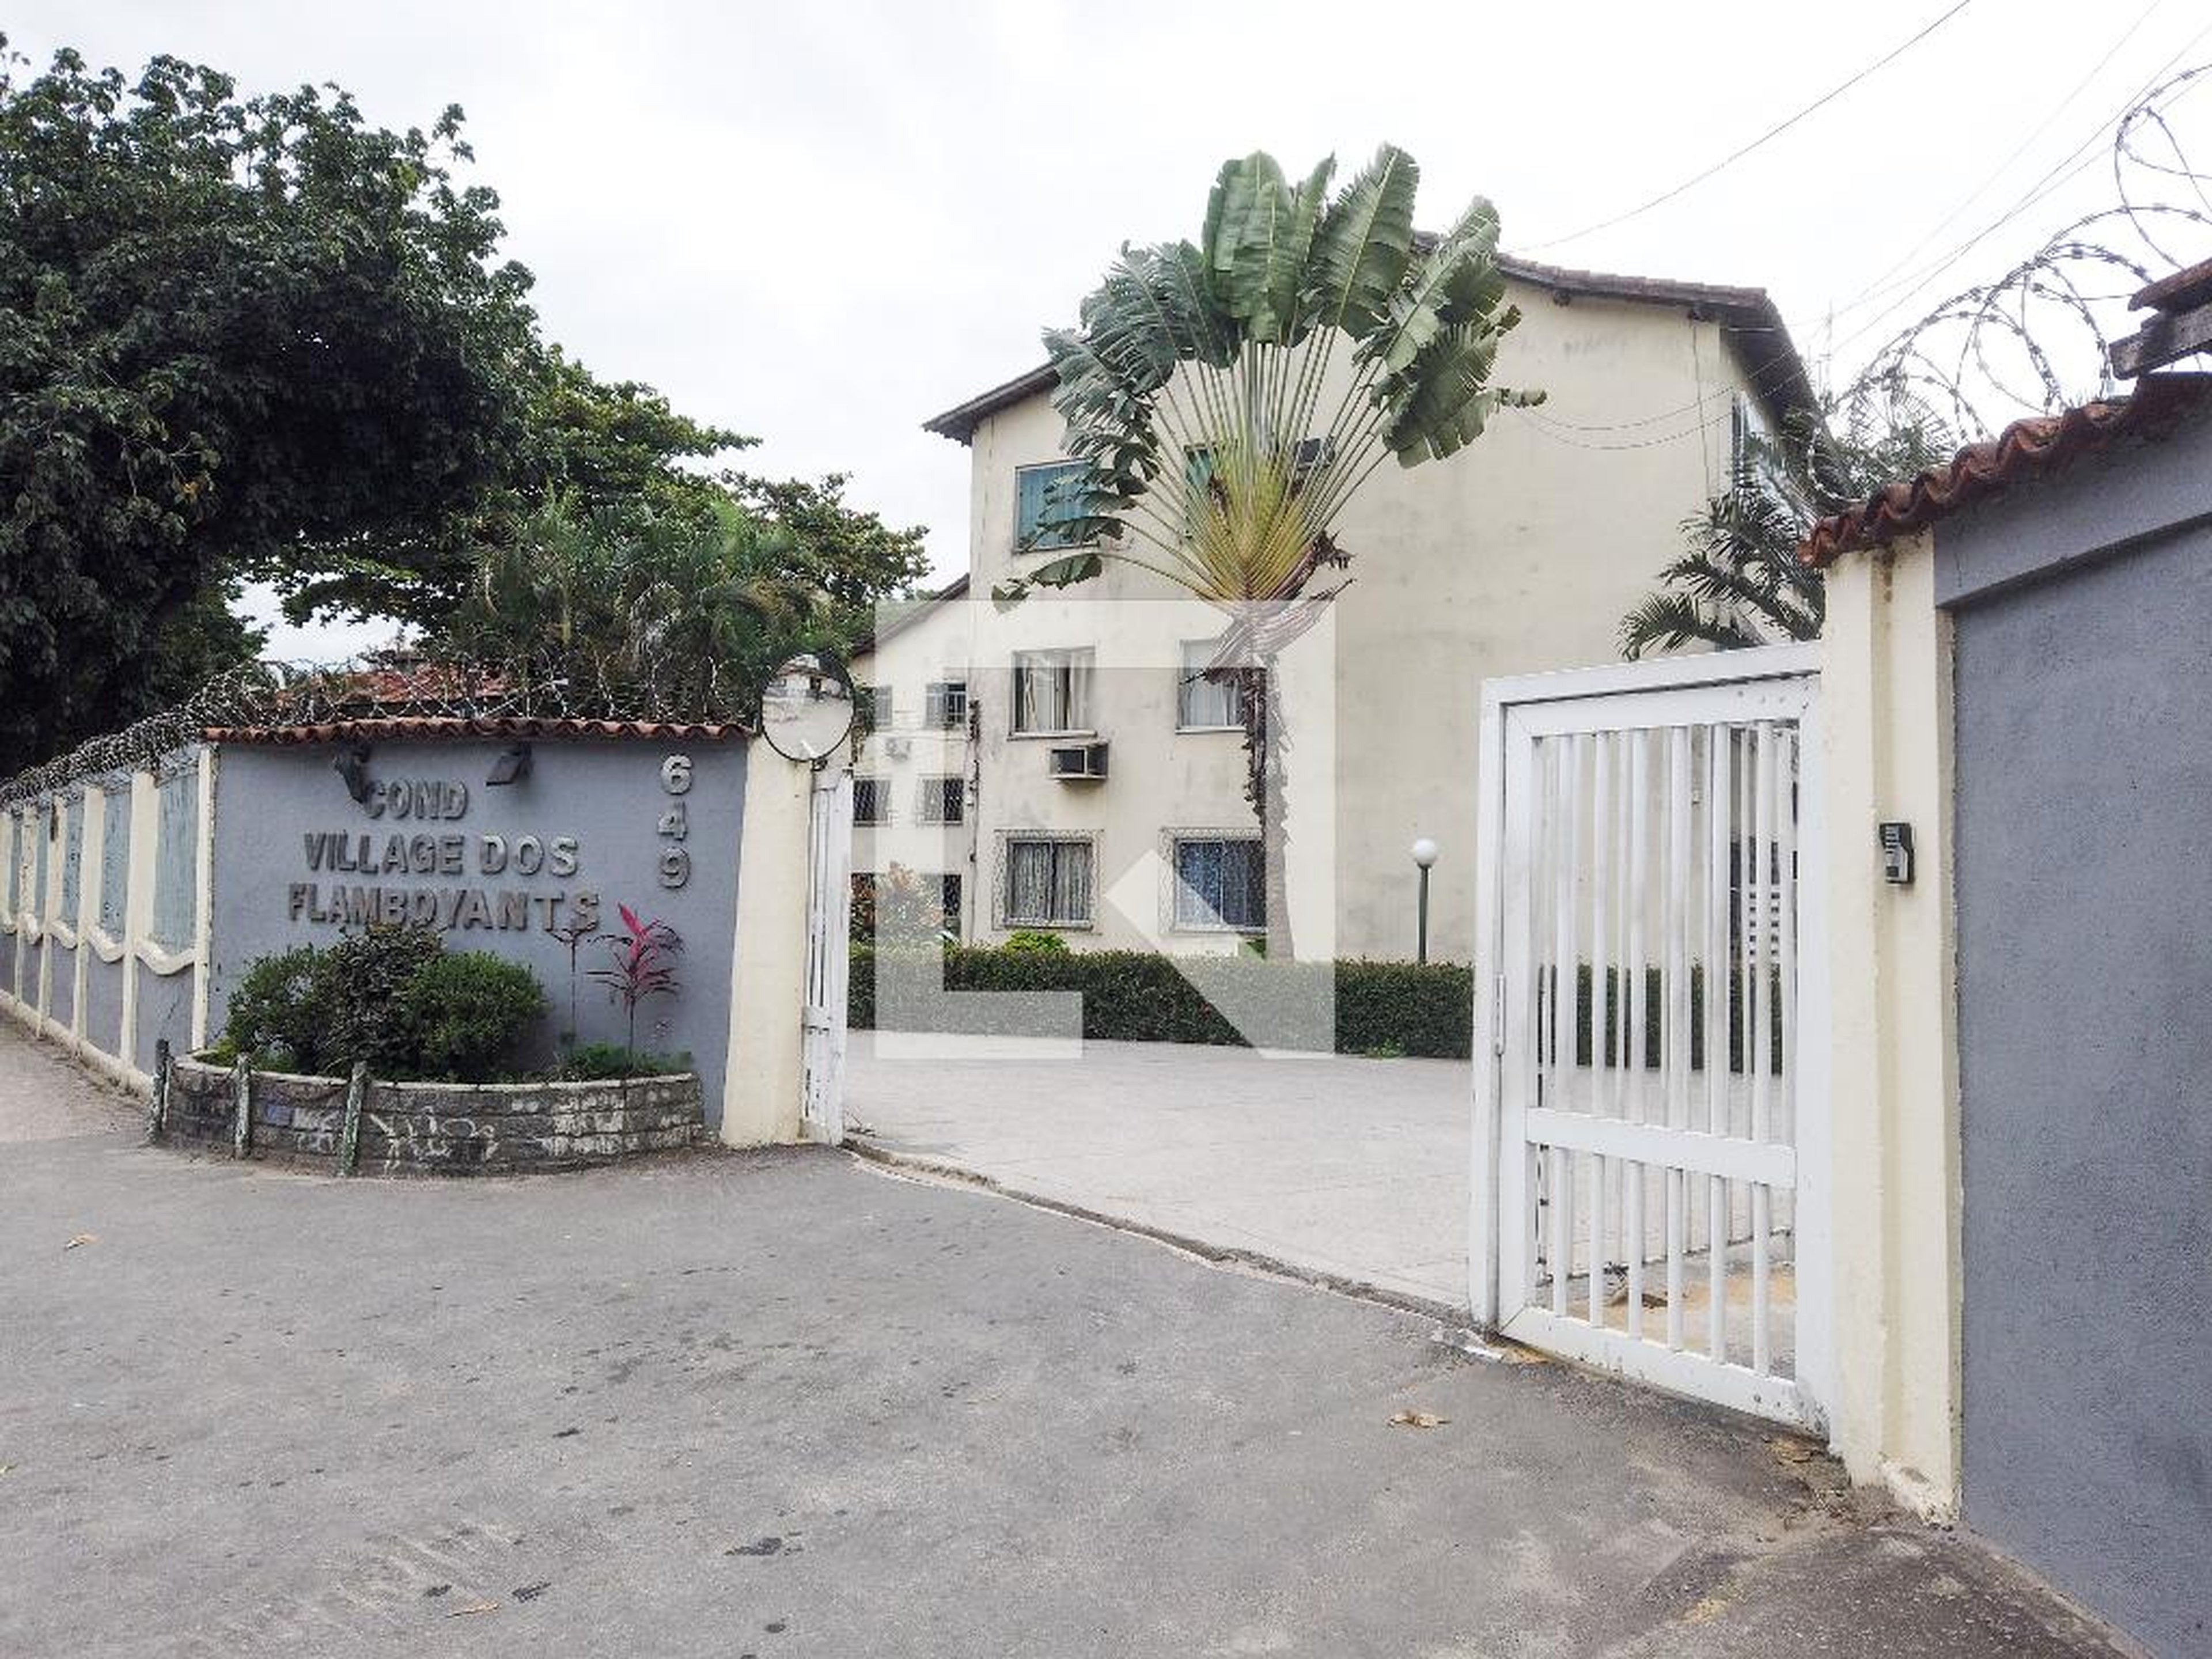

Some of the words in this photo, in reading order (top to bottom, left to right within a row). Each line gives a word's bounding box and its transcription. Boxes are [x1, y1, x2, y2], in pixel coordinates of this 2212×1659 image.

[365, 779, 468, 820] COND
[658, 754, 692, 889] 649
[304, 832, 463, 874] VILLAGE
[479, 834, 579, 877] DOS
[289, 884, 600, 932] FLAMBOYANTS
